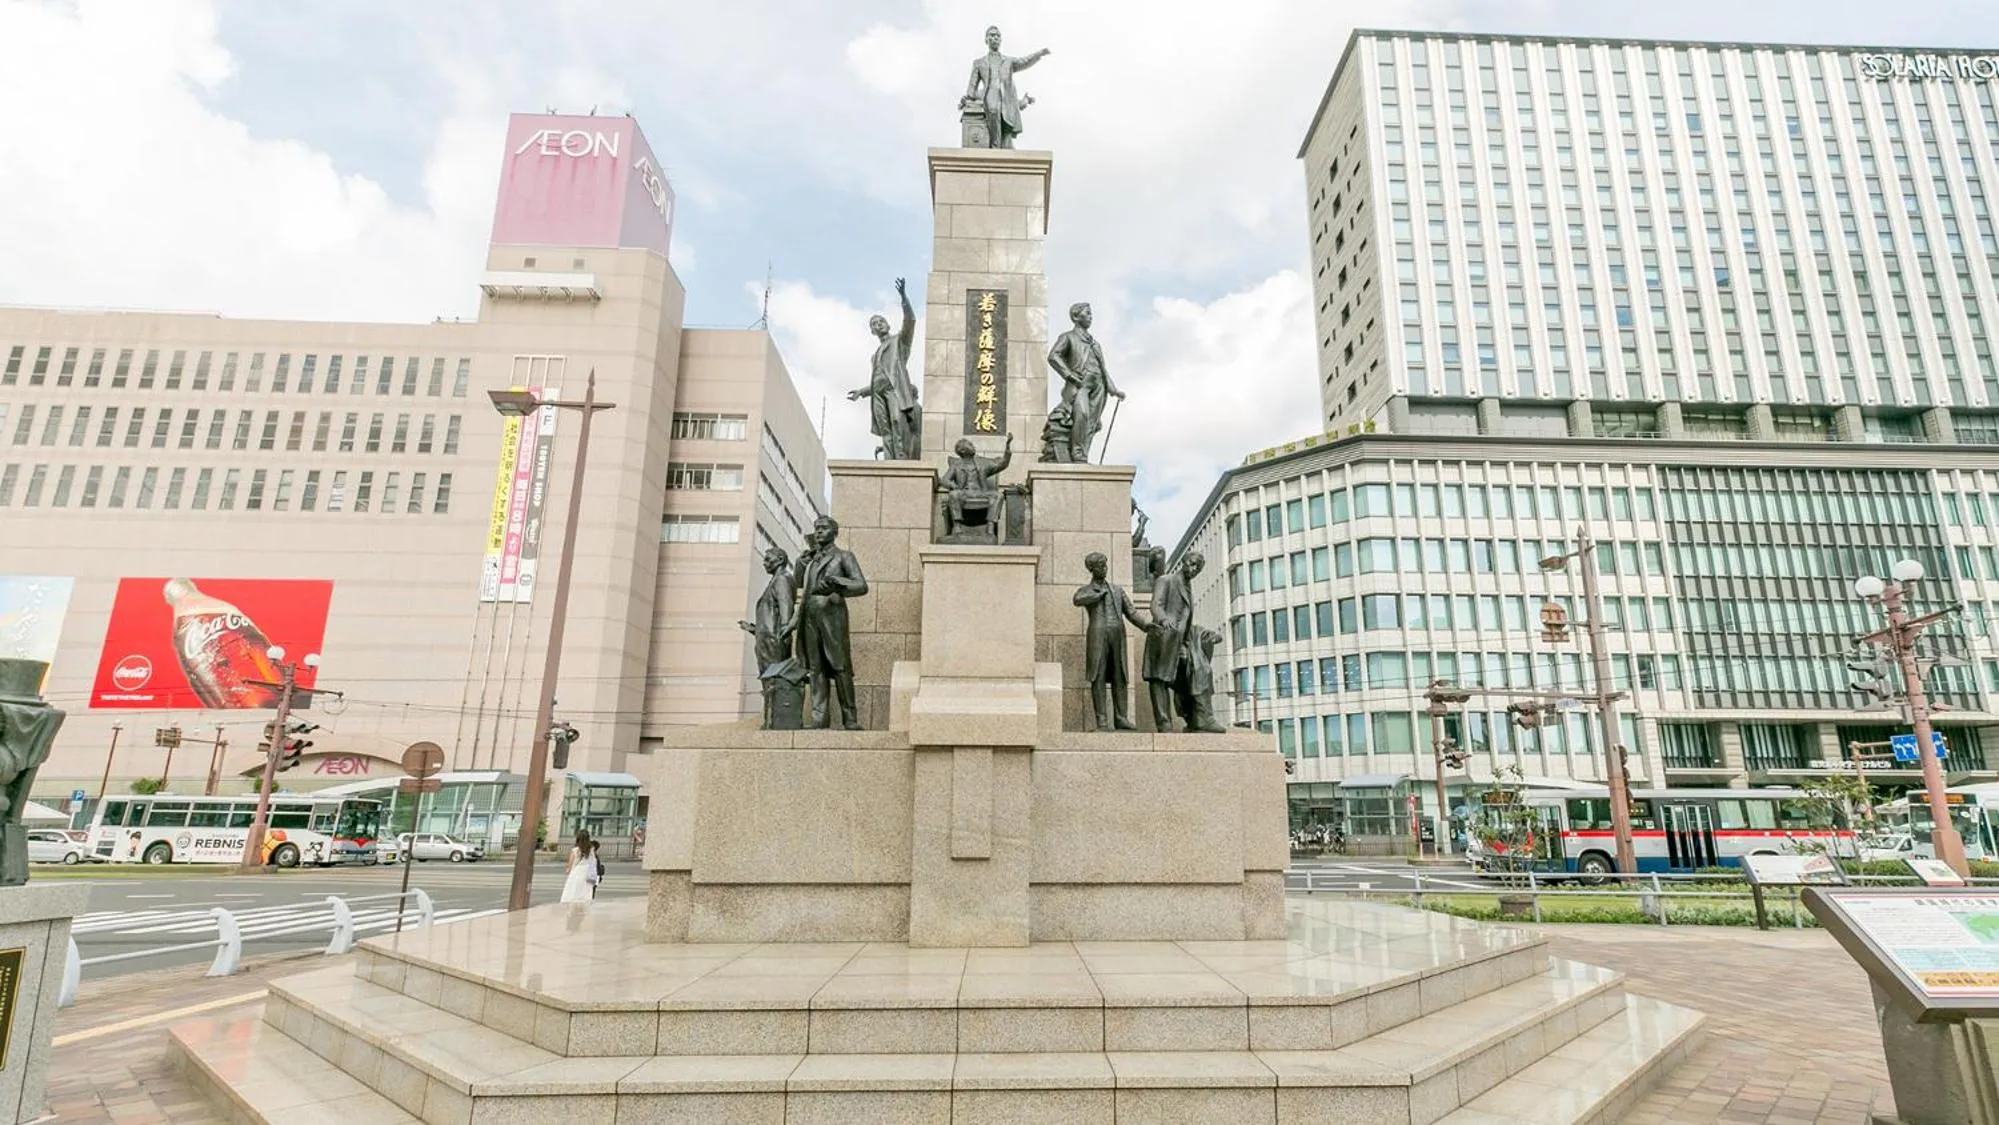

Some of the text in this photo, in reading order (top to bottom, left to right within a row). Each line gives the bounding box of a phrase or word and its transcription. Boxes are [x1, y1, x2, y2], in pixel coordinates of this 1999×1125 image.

[1860, 53, 1999, 79] SOLARIA HO
[973, 292, 998, 432] 若き薩摩の群像
